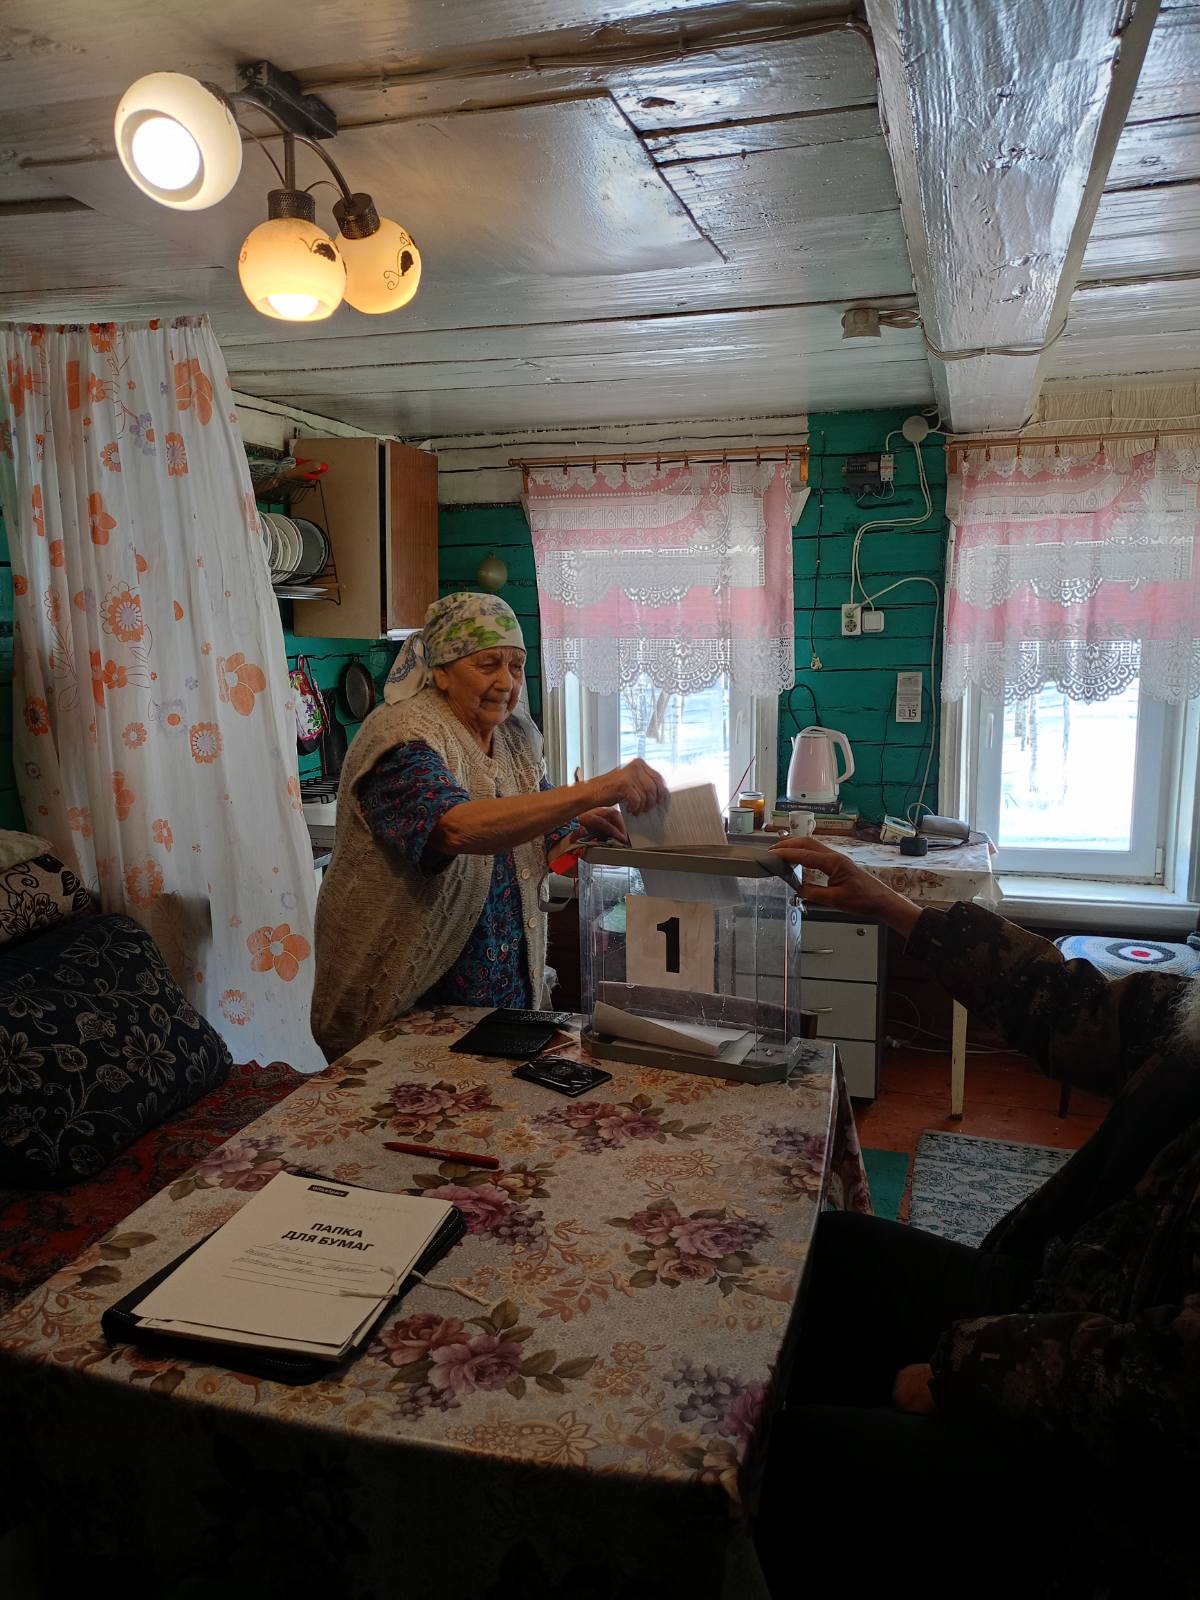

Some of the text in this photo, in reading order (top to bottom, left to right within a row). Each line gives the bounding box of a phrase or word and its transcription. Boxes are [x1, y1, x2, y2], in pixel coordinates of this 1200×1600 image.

[908, 709, 917, 718] 15
[656, 916, 681, 974] 1
[310, 1222, 363, 1238] ПАПКА
[281, 1230, 318, 1243] ДЛЯ
[318, 1236, 375, 1251] БУМАГ
